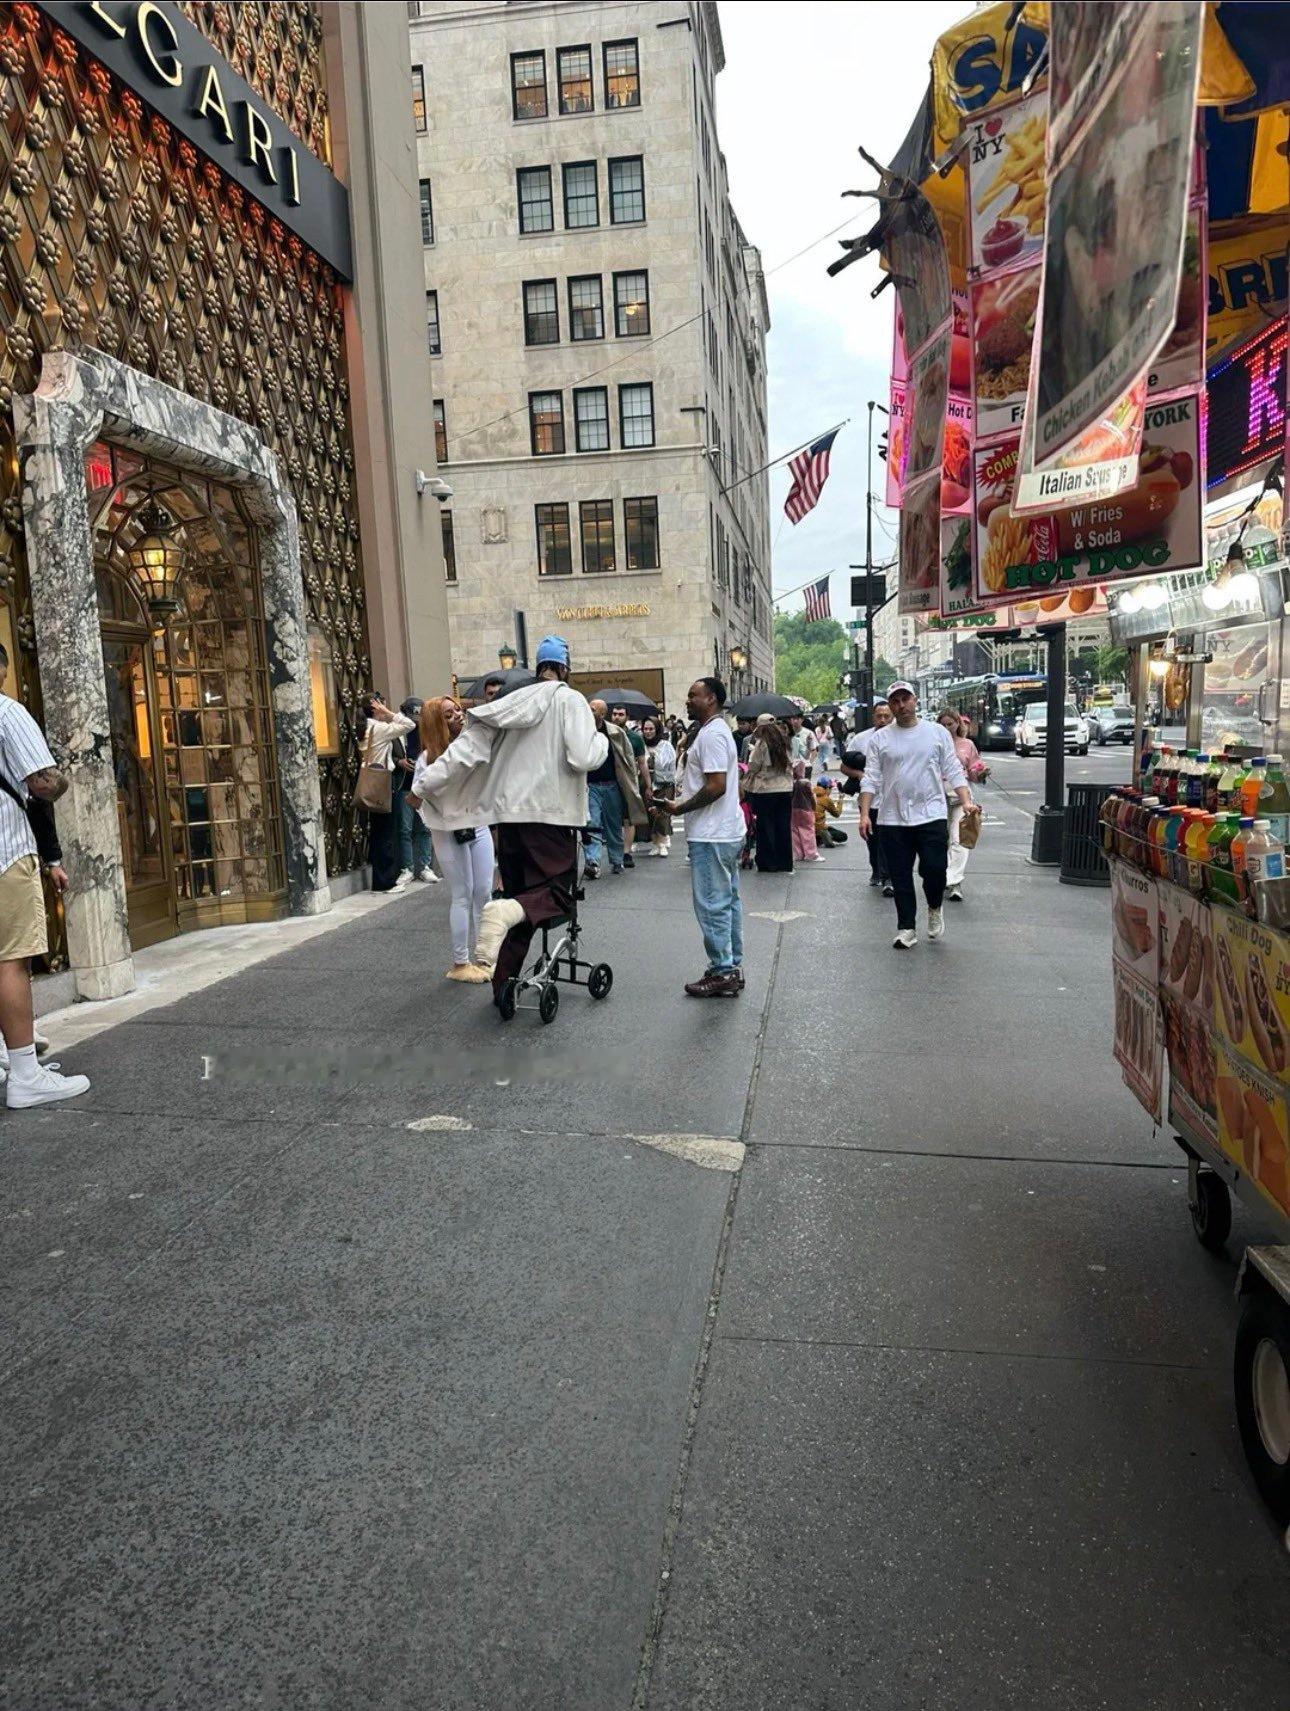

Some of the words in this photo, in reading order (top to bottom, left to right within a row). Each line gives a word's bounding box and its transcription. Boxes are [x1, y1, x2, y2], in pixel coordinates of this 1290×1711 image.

[973, 134, 1006, 164] NY
[948, 402, 965, 418] Hot
[1043, 389, 1091, 443] Chicken
[1143, 403, 1192, 431] YORK
[1040, 469, 1082, 496] Italian
[1085, 464, 1128, 488] Sausge
[1090, 505, 1124, 525] Fries
[1074, 532, 1084, 549] &
[1088, 527, 1122, 548] Soda
[1004, 555, 1082, 589] HOT
[1087, 539, 1172, 577] DOG
[949, 597, 979, 612] HALA
[963, 611, 997, 627] DOG
[1207, 640, 1232, 652] NY
[1226, 916, 1248, 940] Chili
[1251, 925, 1272, 956] Dog
